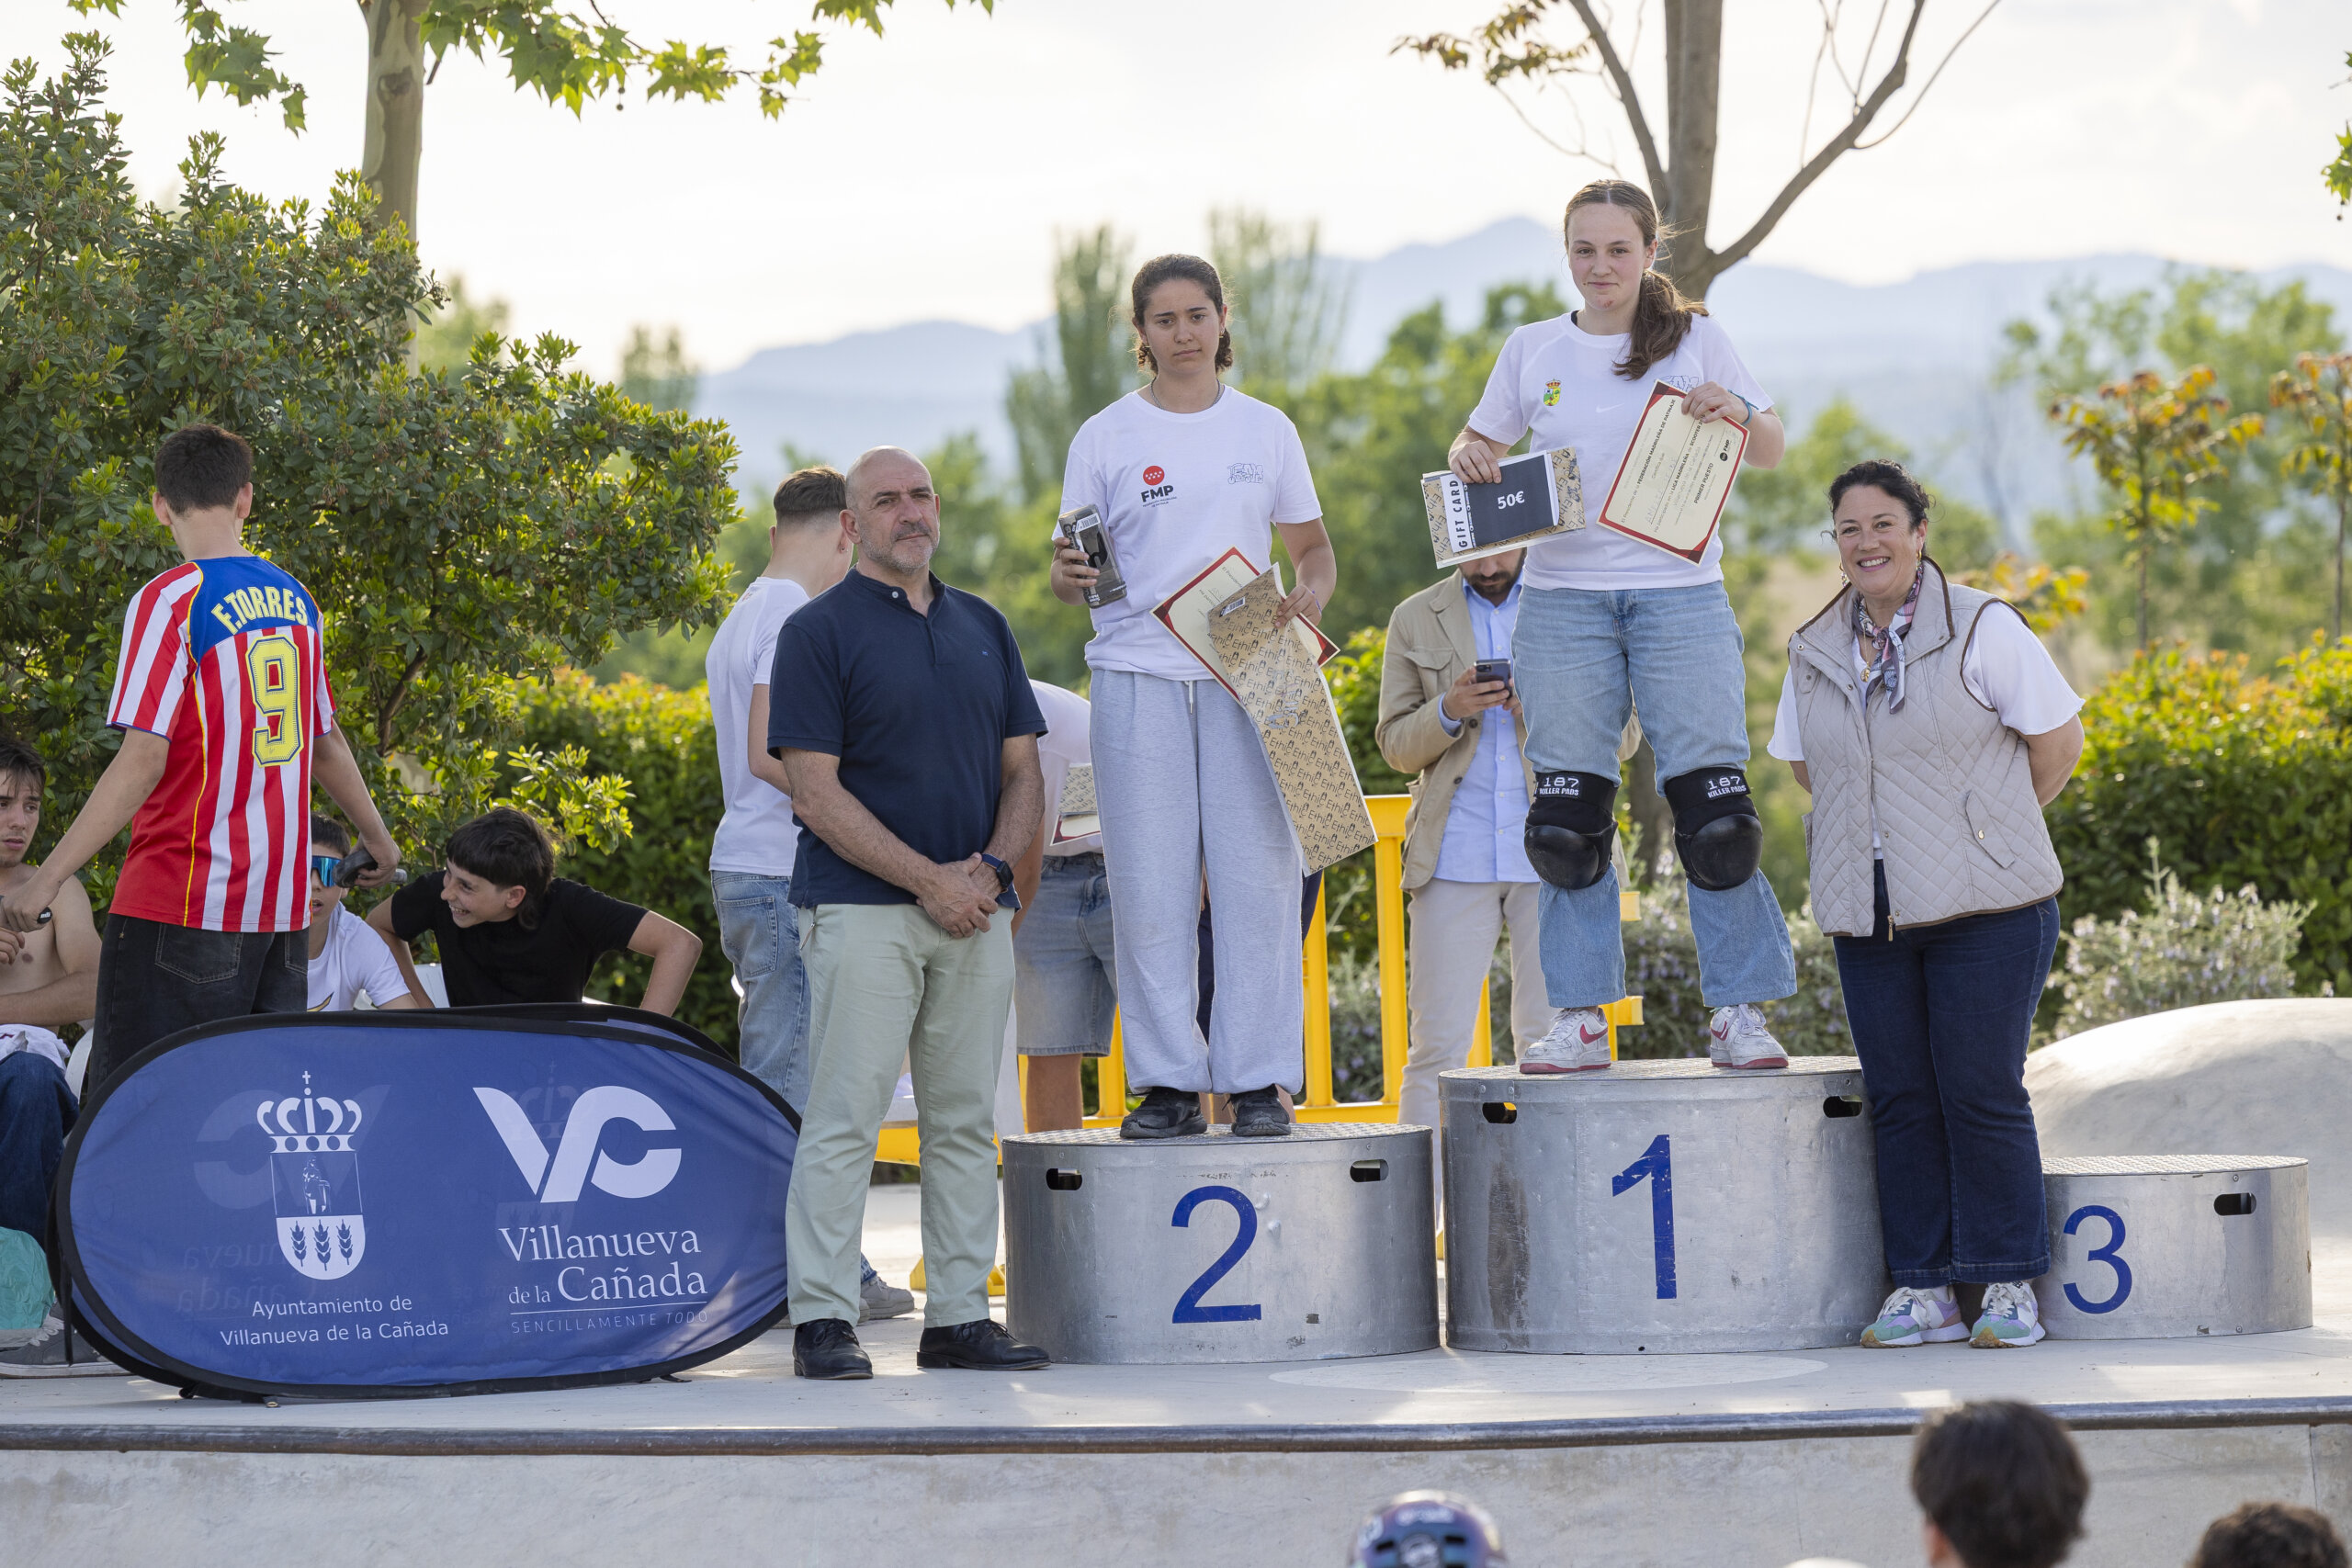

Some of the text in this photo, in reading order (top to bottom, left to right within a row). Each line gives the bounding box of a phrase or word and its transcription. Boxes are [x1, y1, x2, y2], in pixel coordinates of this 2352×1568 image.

[1636, 455, 1651, 483] FEDERACIÓN
[1648, 428, 1663, 455] MADRILEÑA
[1663, 399, 1676, 421] PATINAJE
[1675, 452, 1689, 479] MADRILEÑA
[1690, 424, 1701, 446] SCOOTER
[1723, 439, 1731, 451] FMP
[1141, 485, 1174, 502] FMP
[1497, 491, 1525, 510] 50€
[1693, 483, 1704, 503] PRIMER
[1702, 463, 1713, 482] PUESTO
[1449, 479, 1468, 547] GIFT CARD
[211, 586, 308, 635] F.TORRES
[245, 634, 304, 768] 9
[1539, 787, 1579, 796] KILLER PADS
[1544, 776, 1579, 788] 187
[1707, 784, 1747, 798] KILLER PADS
[1708, 775, 1741, 791] 187
[472, 1081, 683, 1203] VC
[1612, 1134, 1678, 1299] 1
[498, 1224, 702, 1262] Villanueva
[1171, 1186, 1262, 1324] 2
[2063, 1204, 2133, 1314] 3
[508, 1261, 708, 1304] de la Cañada
[252, 1295, 413, 1320] Ayuntamiento de
[512, 1310, 707, 1334] SENCILLAMENTE TODO
[220, 1321, 449, 1346] Villanueva de la Cañada
